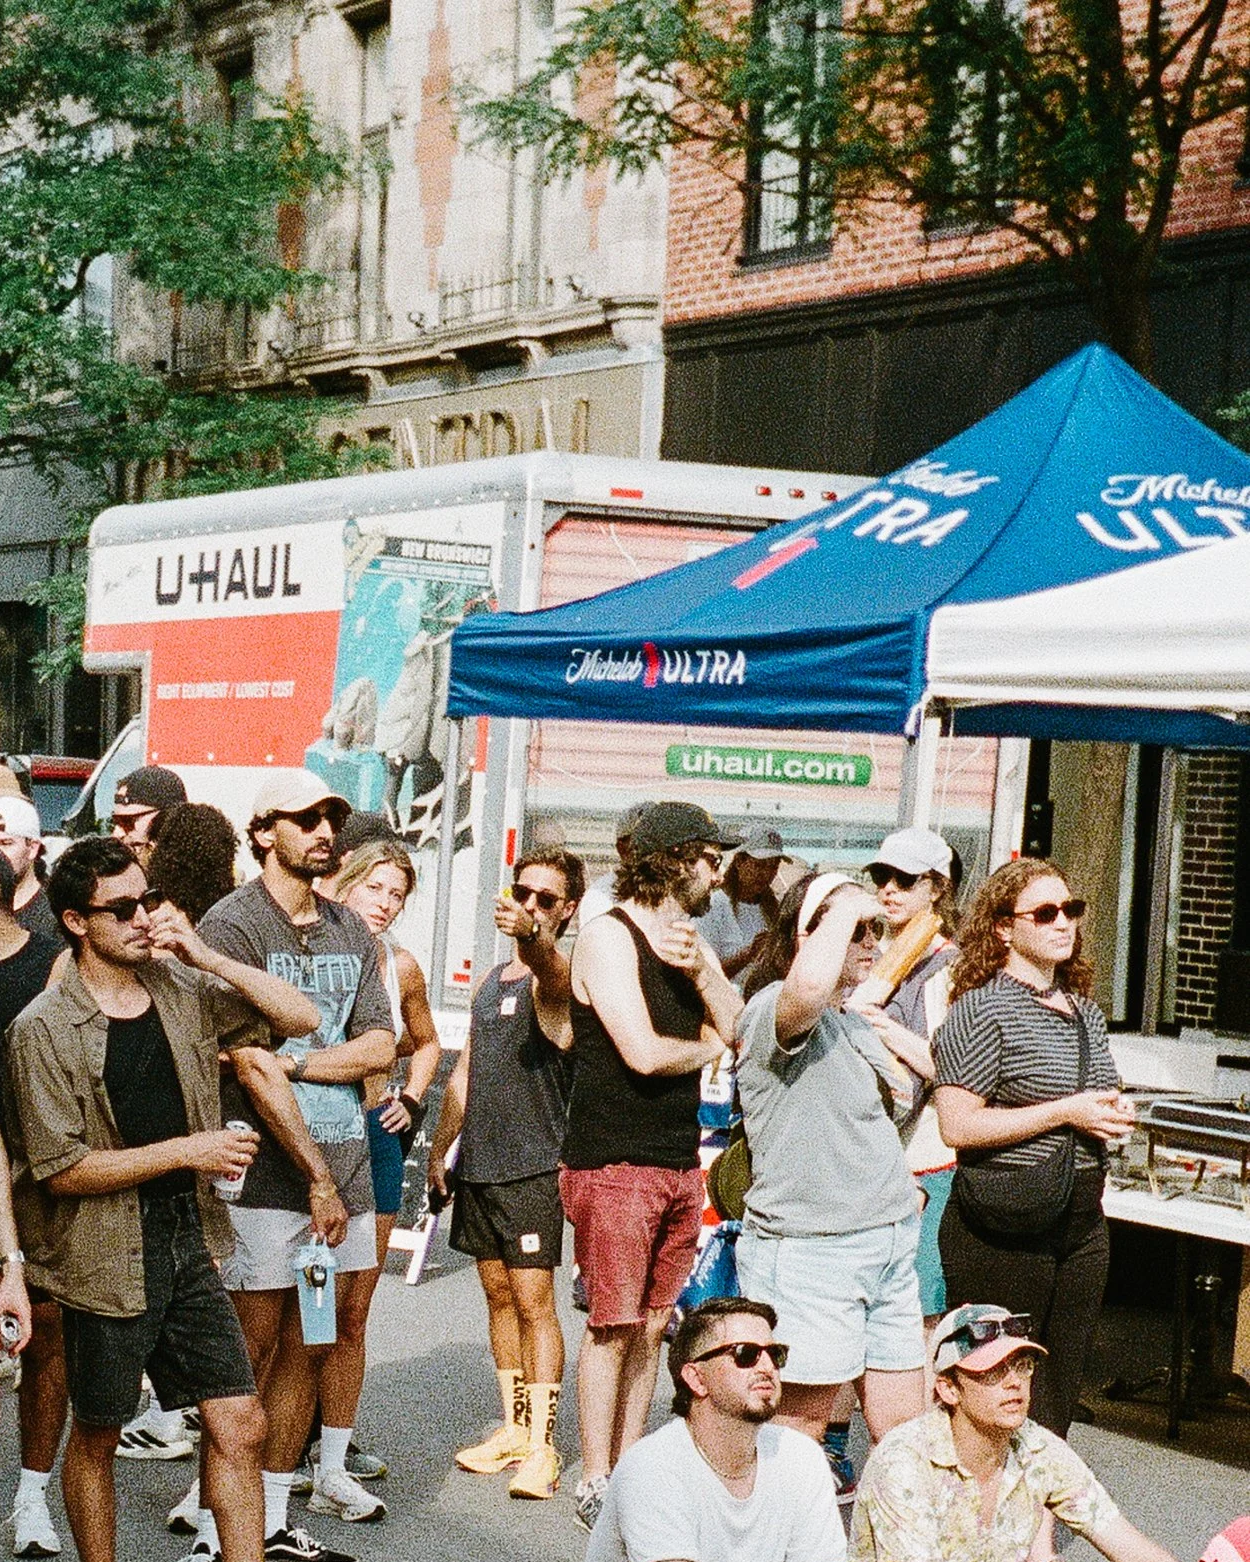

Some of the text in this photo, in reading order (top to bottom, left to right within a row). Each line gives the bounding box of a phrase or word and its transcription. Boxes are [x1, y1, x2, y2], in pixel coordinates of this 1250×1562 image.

[1100, 472, 1250, 507] Miche
[816, 489, 969, 549] TRA
[1076, 505, 1250, 551] ULT
[565, 648, 747, 685] Michelob ULTRA
[681, 750, 856, 782] uhaul.com
